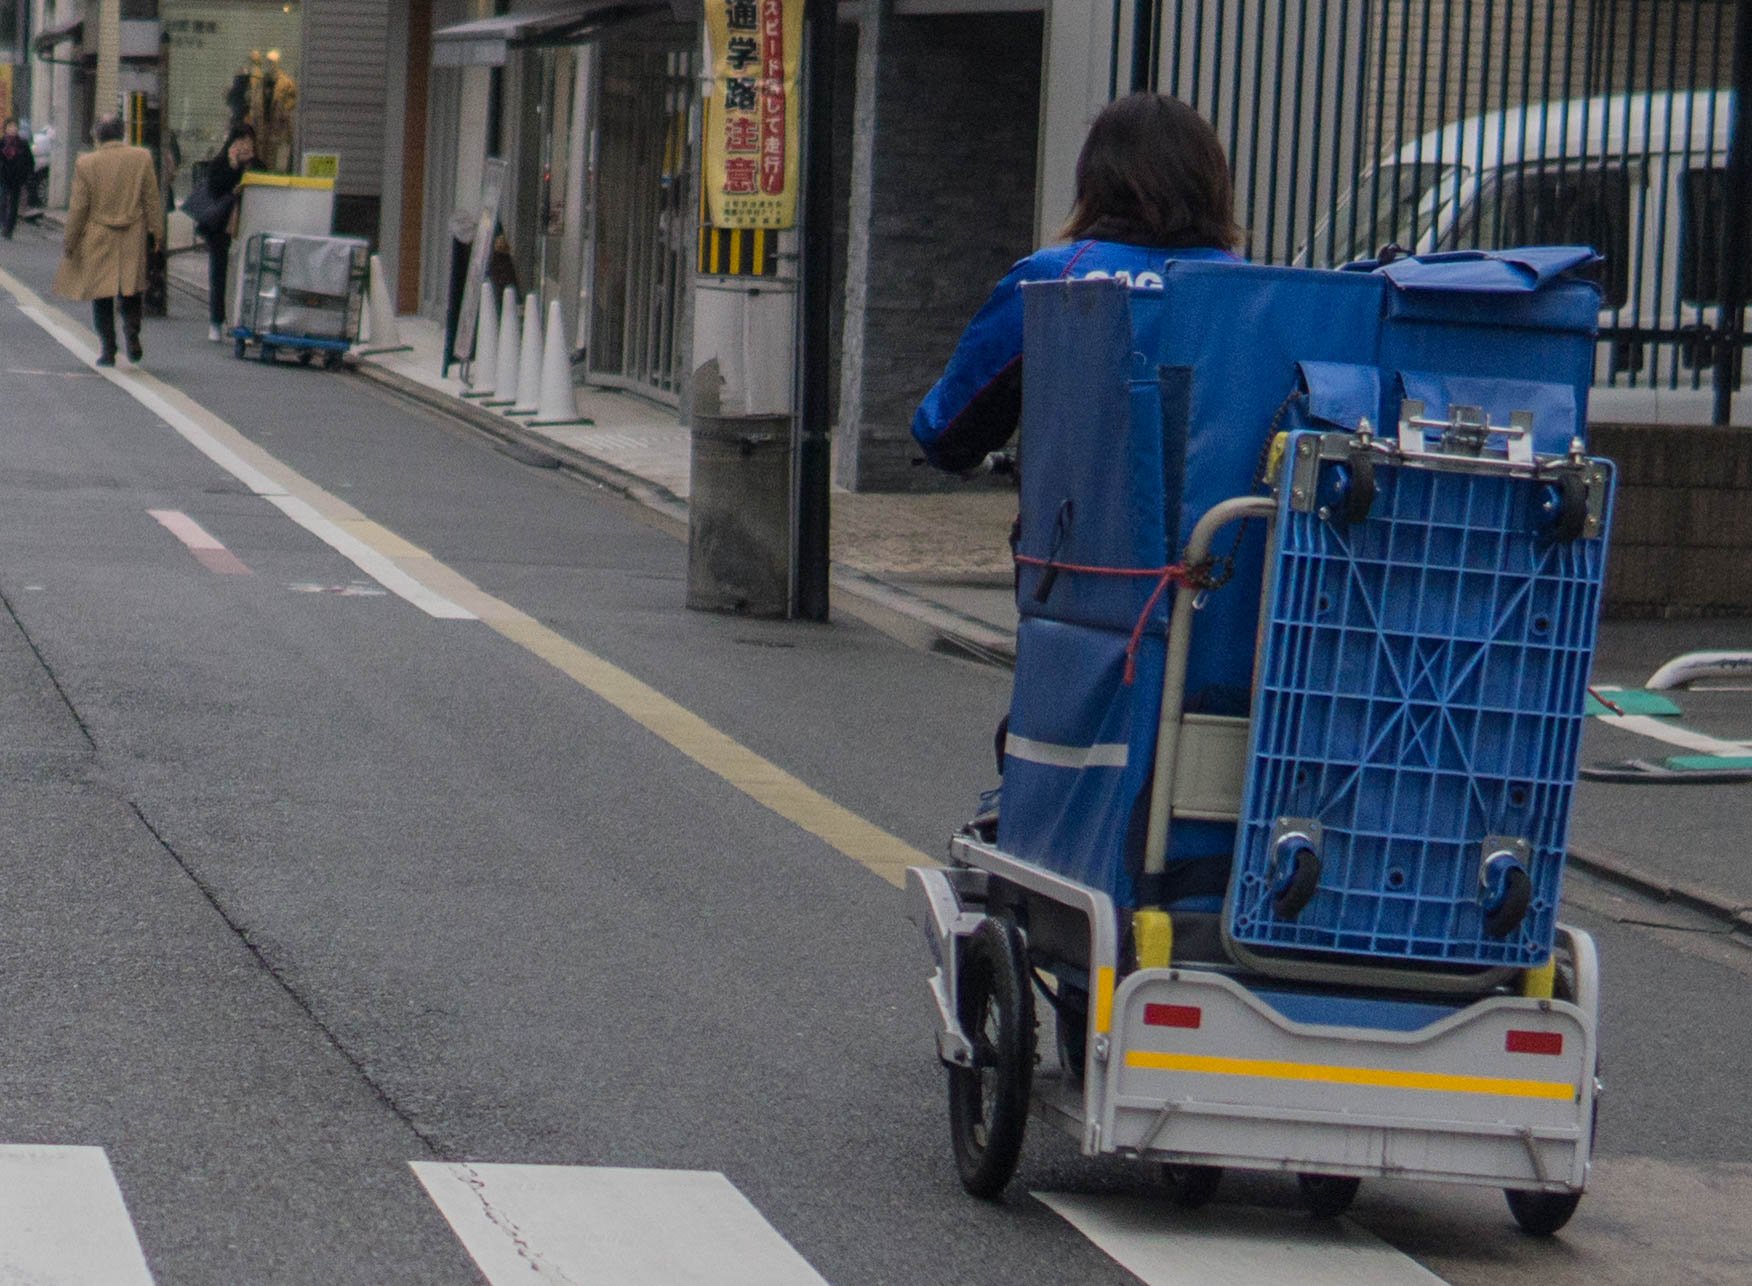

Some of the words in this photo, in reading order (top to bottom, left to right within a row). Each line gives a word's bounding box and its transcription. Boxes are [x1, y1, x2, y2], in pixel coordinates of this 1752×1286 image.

[725, 0, 758, 193] 通学路注意
